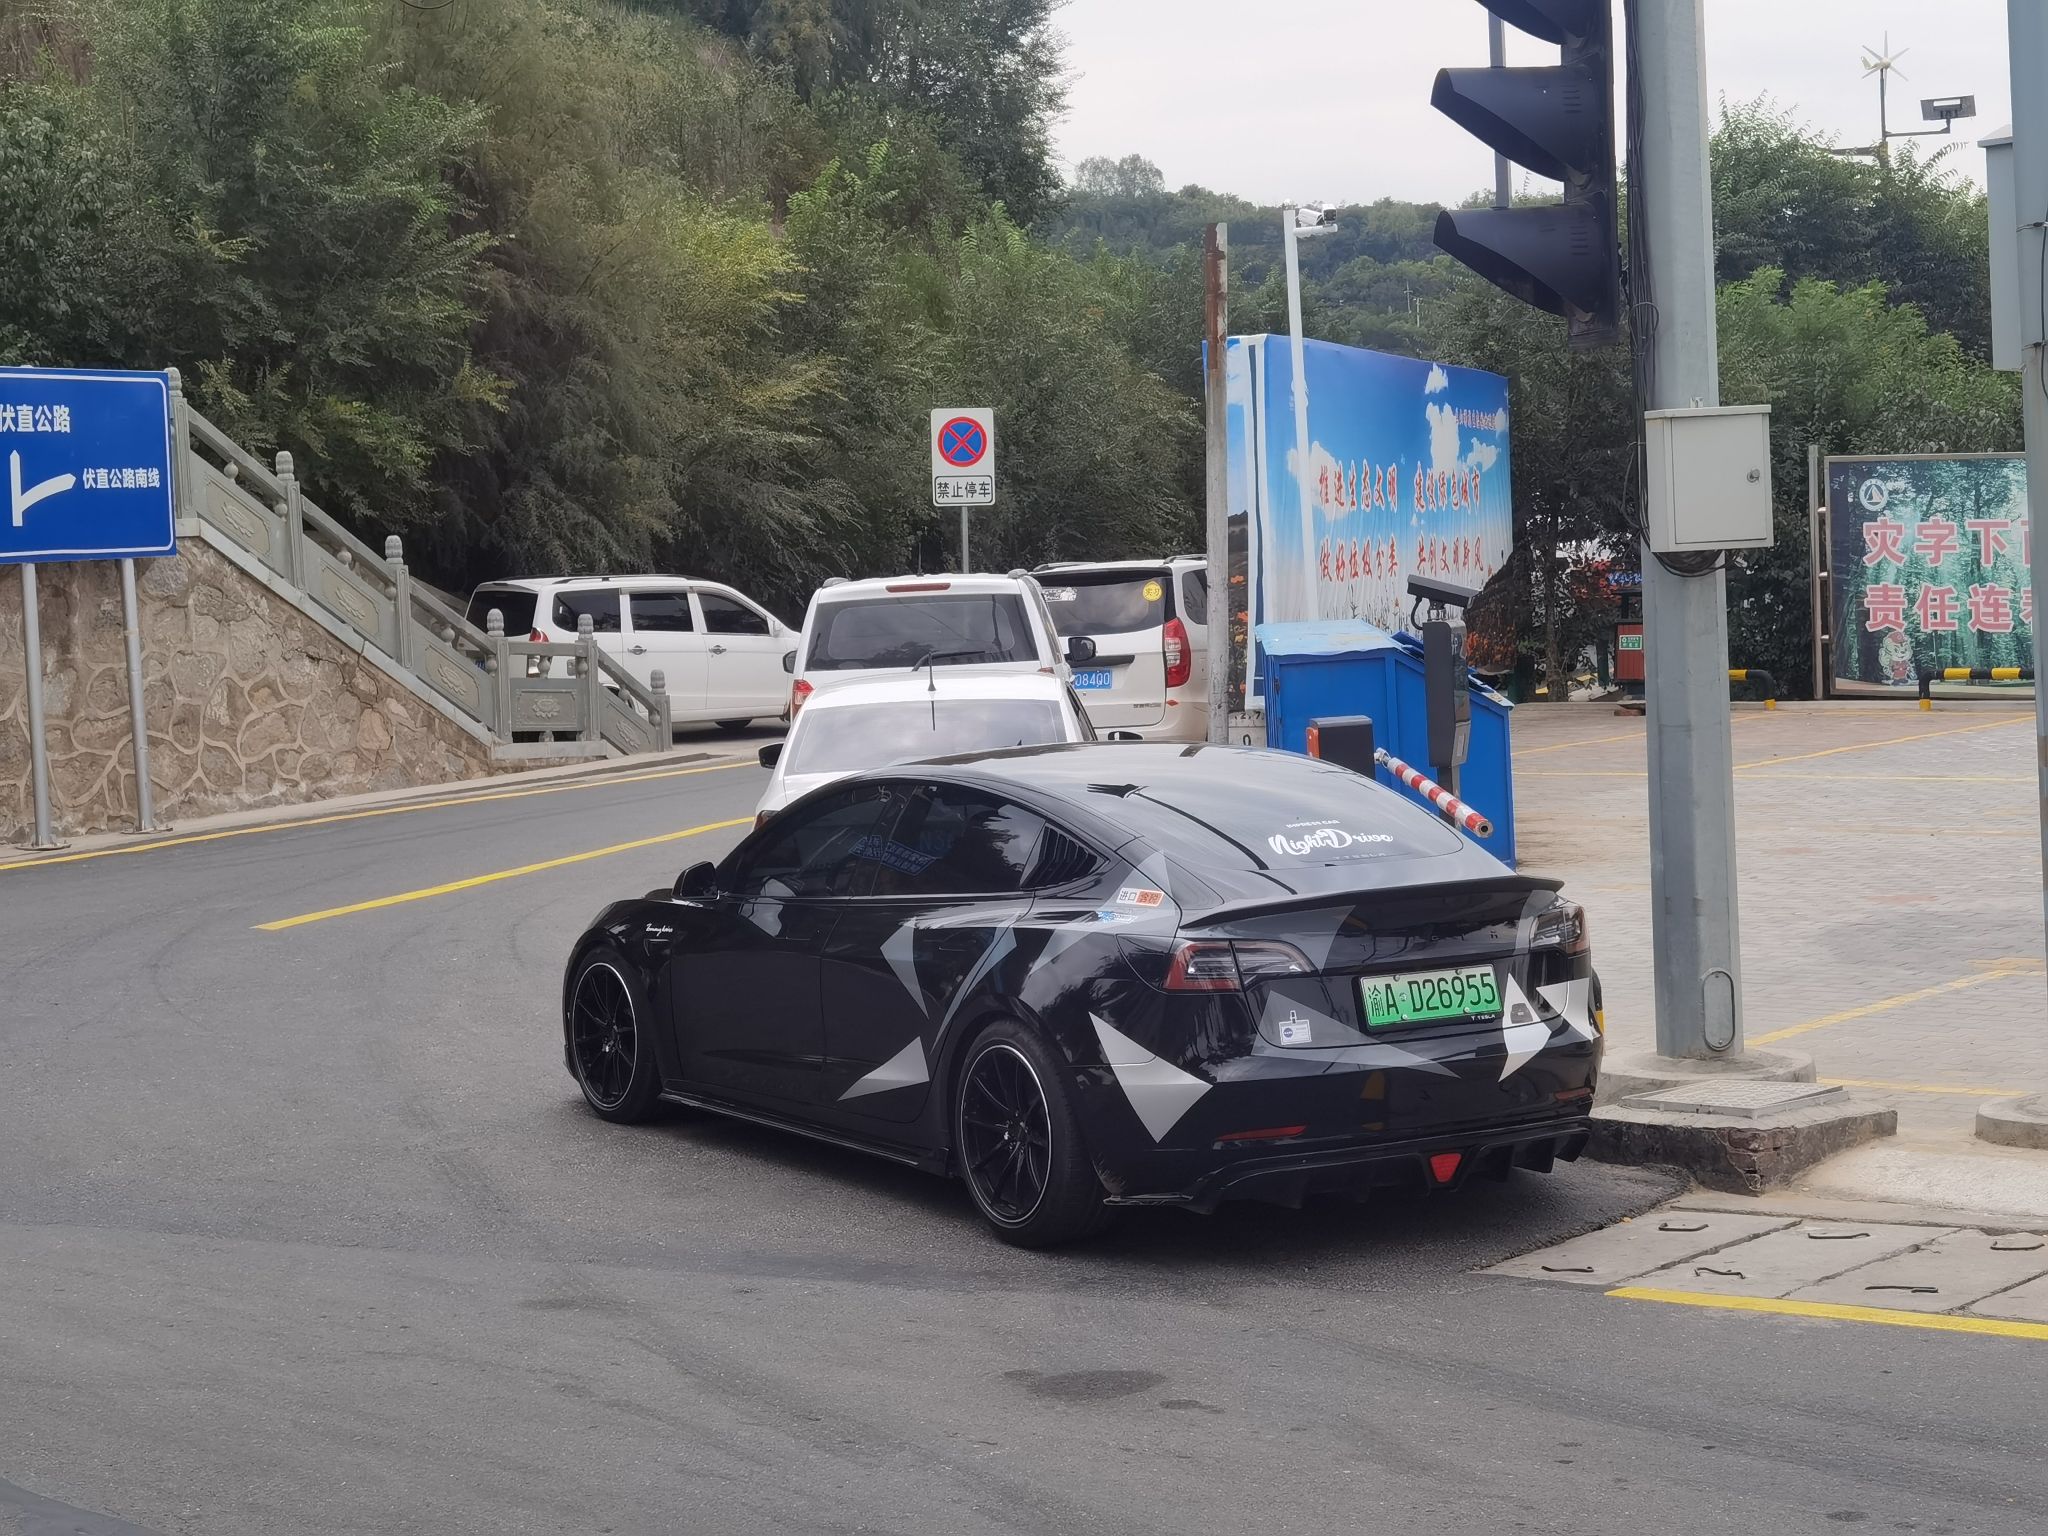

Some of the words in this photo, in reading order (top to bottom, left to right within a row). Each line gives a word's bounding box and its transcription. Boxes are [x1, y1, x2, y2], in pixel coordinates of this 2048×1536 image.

[0, 404, 71, 433] 伏直公路
[82, 467, 160, 489] 伏直公路南线
[937, 481, 991, 498] 禁止停车
